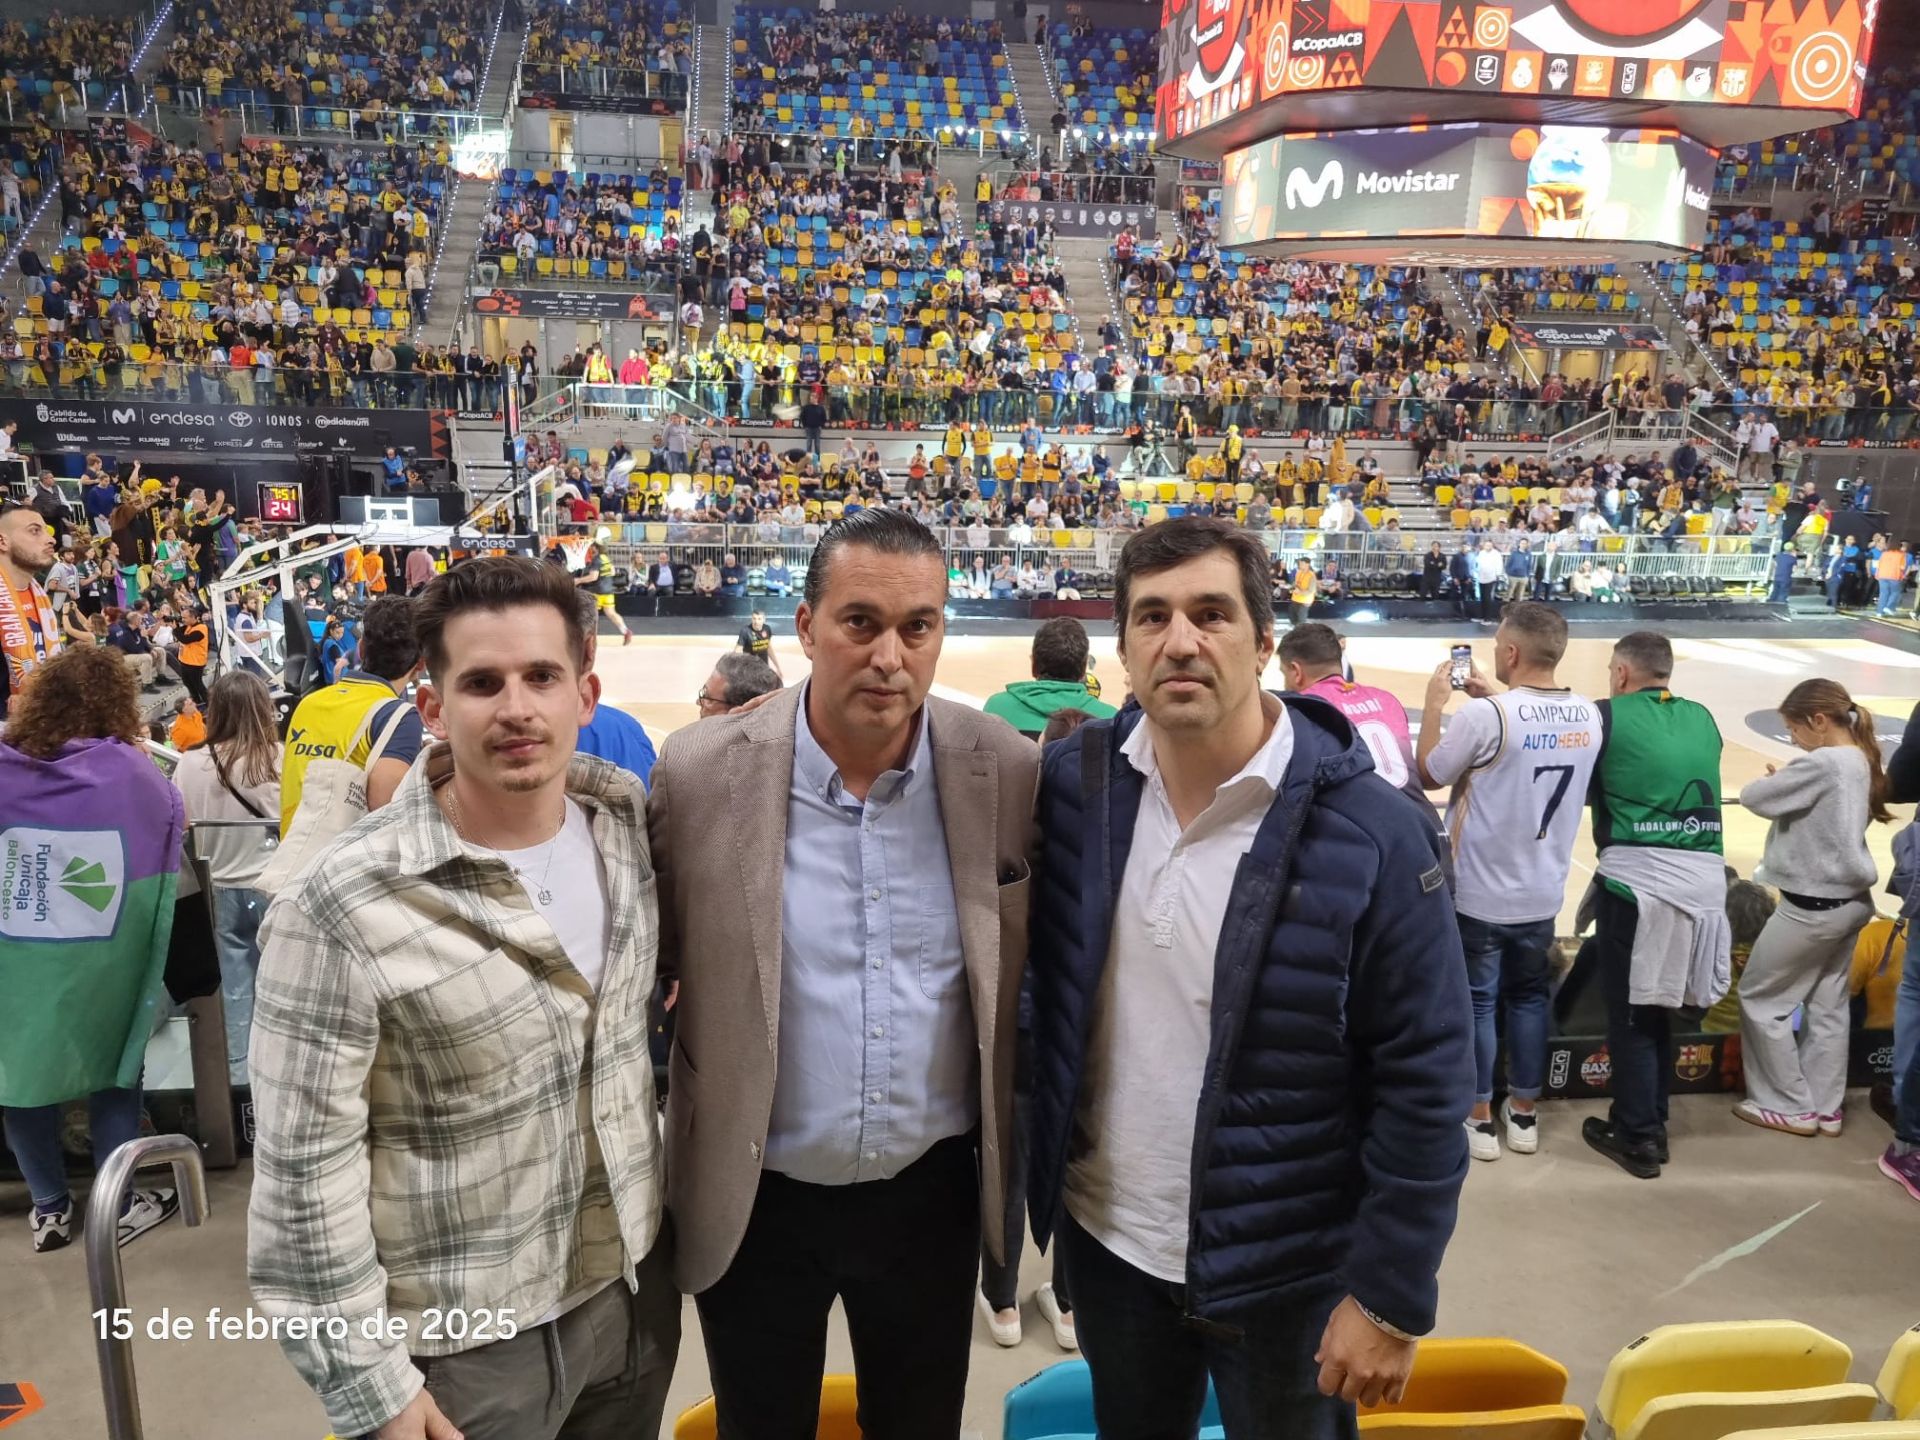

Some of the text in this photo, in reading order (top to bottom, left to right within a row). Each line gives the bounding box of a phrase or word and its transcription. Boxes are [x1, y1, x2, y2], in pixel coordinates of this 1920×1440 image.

[1292, 32, 1362, 50] #CopaACB
[1356, 169, 1459, 194] Movistar
[69, 416, 96, 424] Canaria
[150, 411, 215, 426] endesa
[266, 415, 302, 426] IONOS
[56, 433, 88, 442] Wilson
[271, 501, 291, 516] 24
[461, 538, 516, 549] endesa
[1518, 704, 1590, 723] CAMPAZZO
[1522, 731, 1590, 750] AUTOHERO
[1532, 765, 1575, 840] 7
[2, 839, 18, 920] Baloncesto
[13, 853, 33, 911] Unicaja
[33, 843, 51, 922] Fundación
